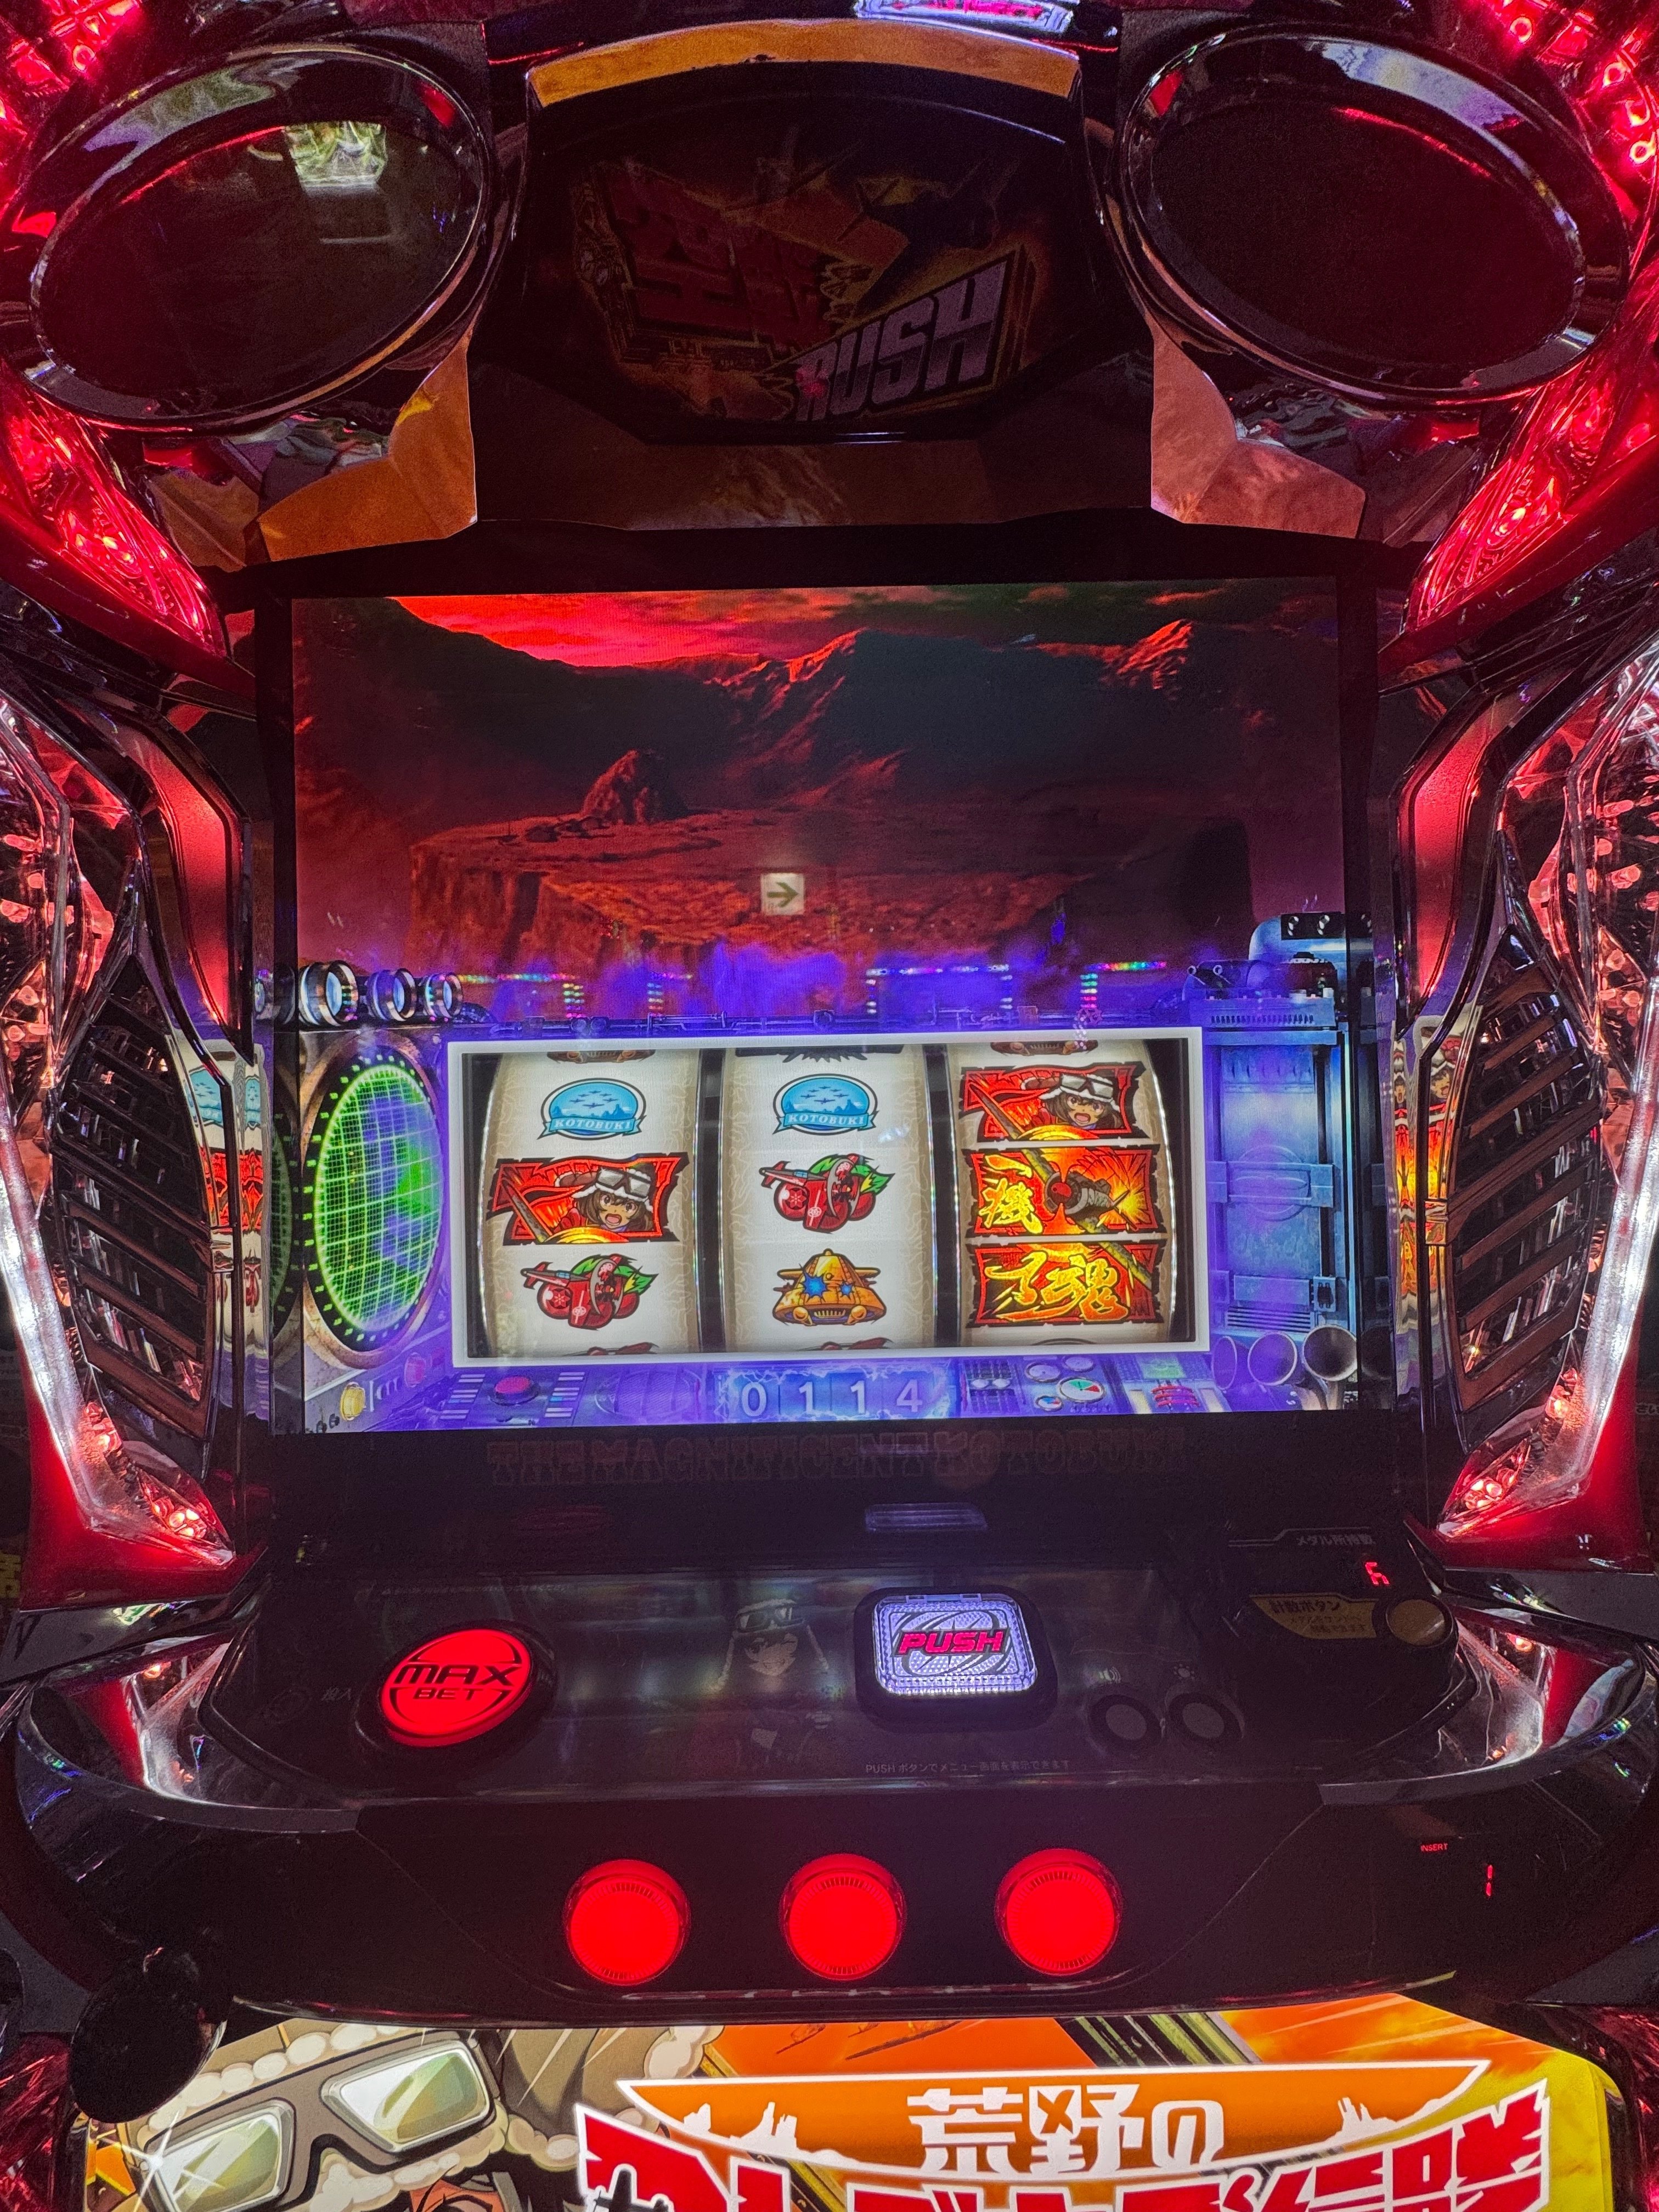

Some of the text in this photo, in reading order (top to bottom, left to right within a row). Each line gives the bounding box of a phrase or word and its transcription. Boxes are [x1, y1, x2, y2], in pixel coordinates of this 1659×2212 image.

[796, 259, 1007, 422] RUSH
[554, 1118, 631, 1130] KOTOBUKI
[787, 1113, 865, 1125] KOTOBUKI
[741, 1378, 923, 1417] 0114
[487, 1427, 1186, 1486] THE MAGNIFICENT KOTOBUKI
[896, 1629, 1006, 1656] PUSH
[393, 1663, 524, 1686] MAX
[412, 1687, 484, 1701] BET
[1420, 1842, 1448, 1853] INSERT
[1483, 1863, 1495, 1900] 1
[906, 2086, 1224, 2174] 荒野の
